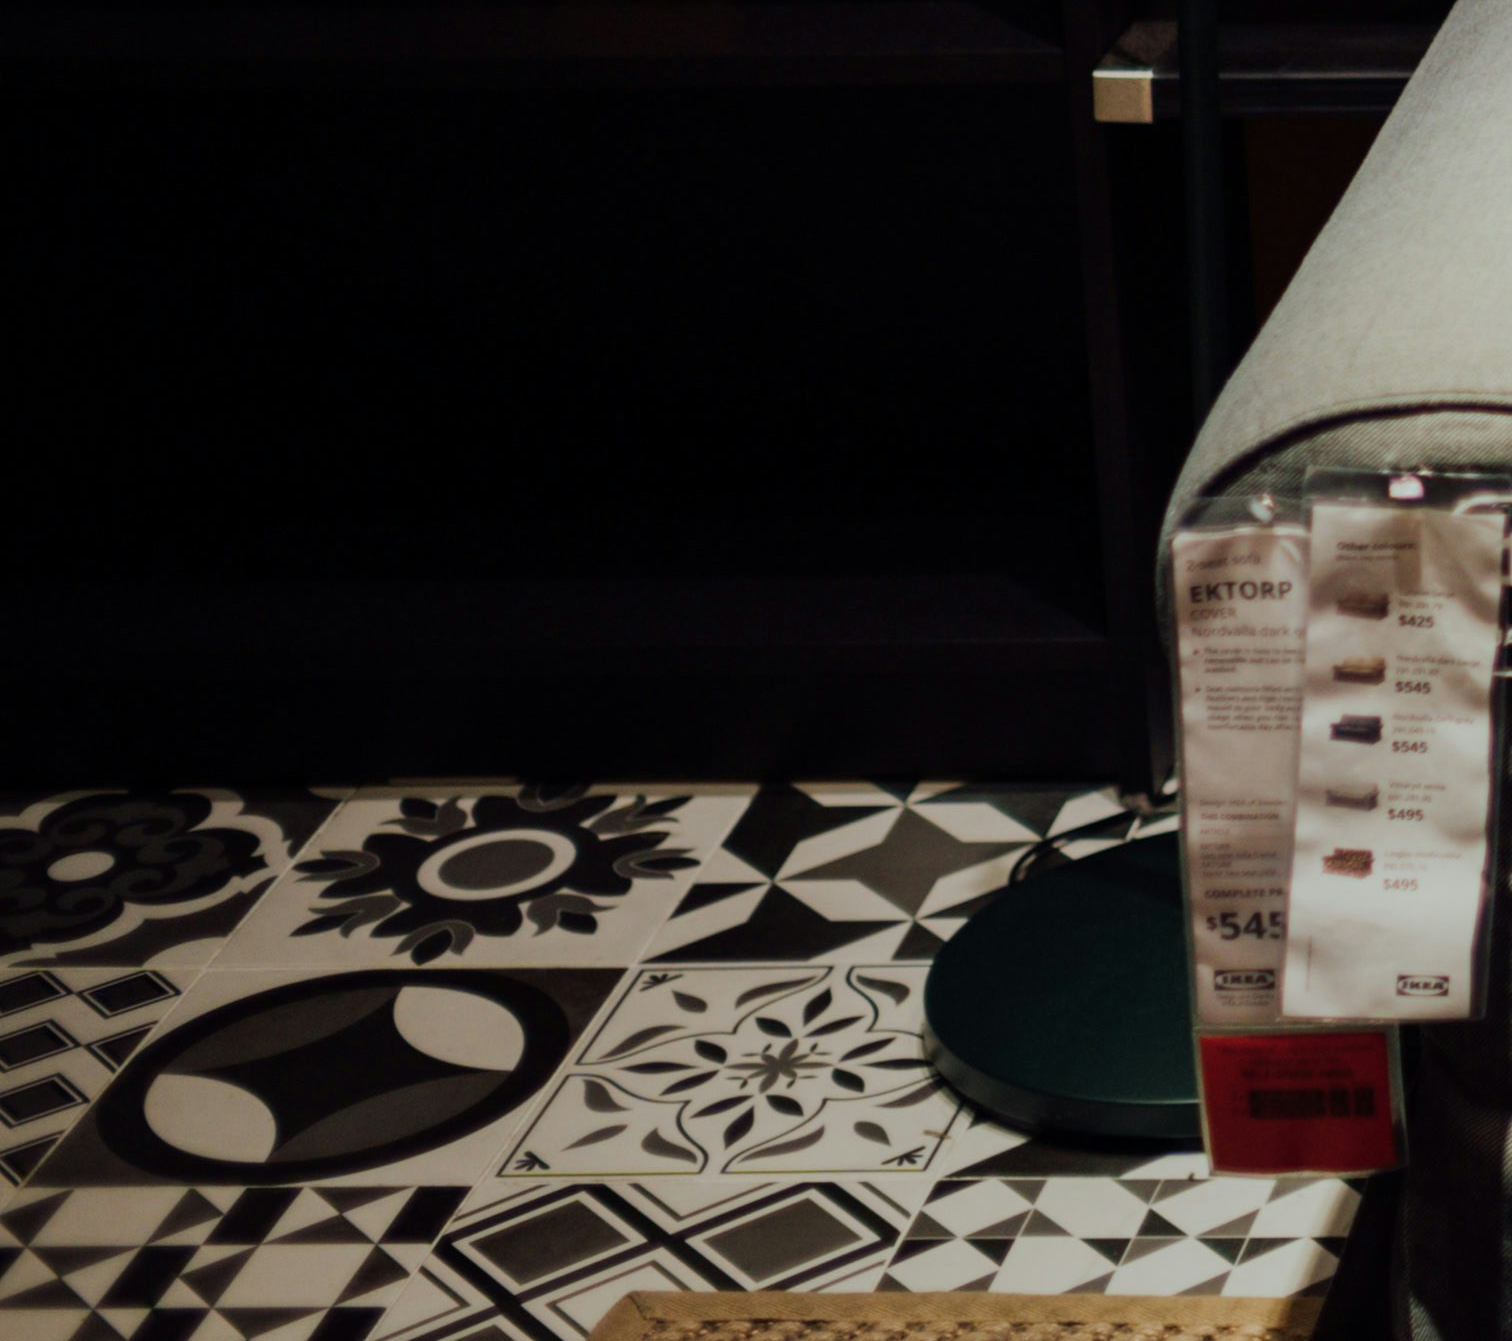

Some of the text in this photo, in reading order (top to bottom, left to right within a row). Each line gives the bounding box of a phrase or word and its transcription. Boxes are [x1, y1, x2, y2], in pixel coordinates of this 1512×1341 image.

[1233, 554, 1261, 566] sofa
[1190, 581, 1292, 604] EKTORP
[1191, 608, 1237, 621] COVER
[1399, 615, 1435, 628] $425
[1261, 625, 1291, 637] dark
[1395, 681, 1431, 694] $545
[1392, 741, 1428, 753] $545
[1388, 809, 1424, 821] $495
[1383, 879, 1418, 891] $495
[1205, 888, 1265, 899] COMPLETE
[1206, 911, 1285, 941] $545
[1222, 974, 1268, 984] IKEA
[1401, 980, 1445, 991] IKEA
